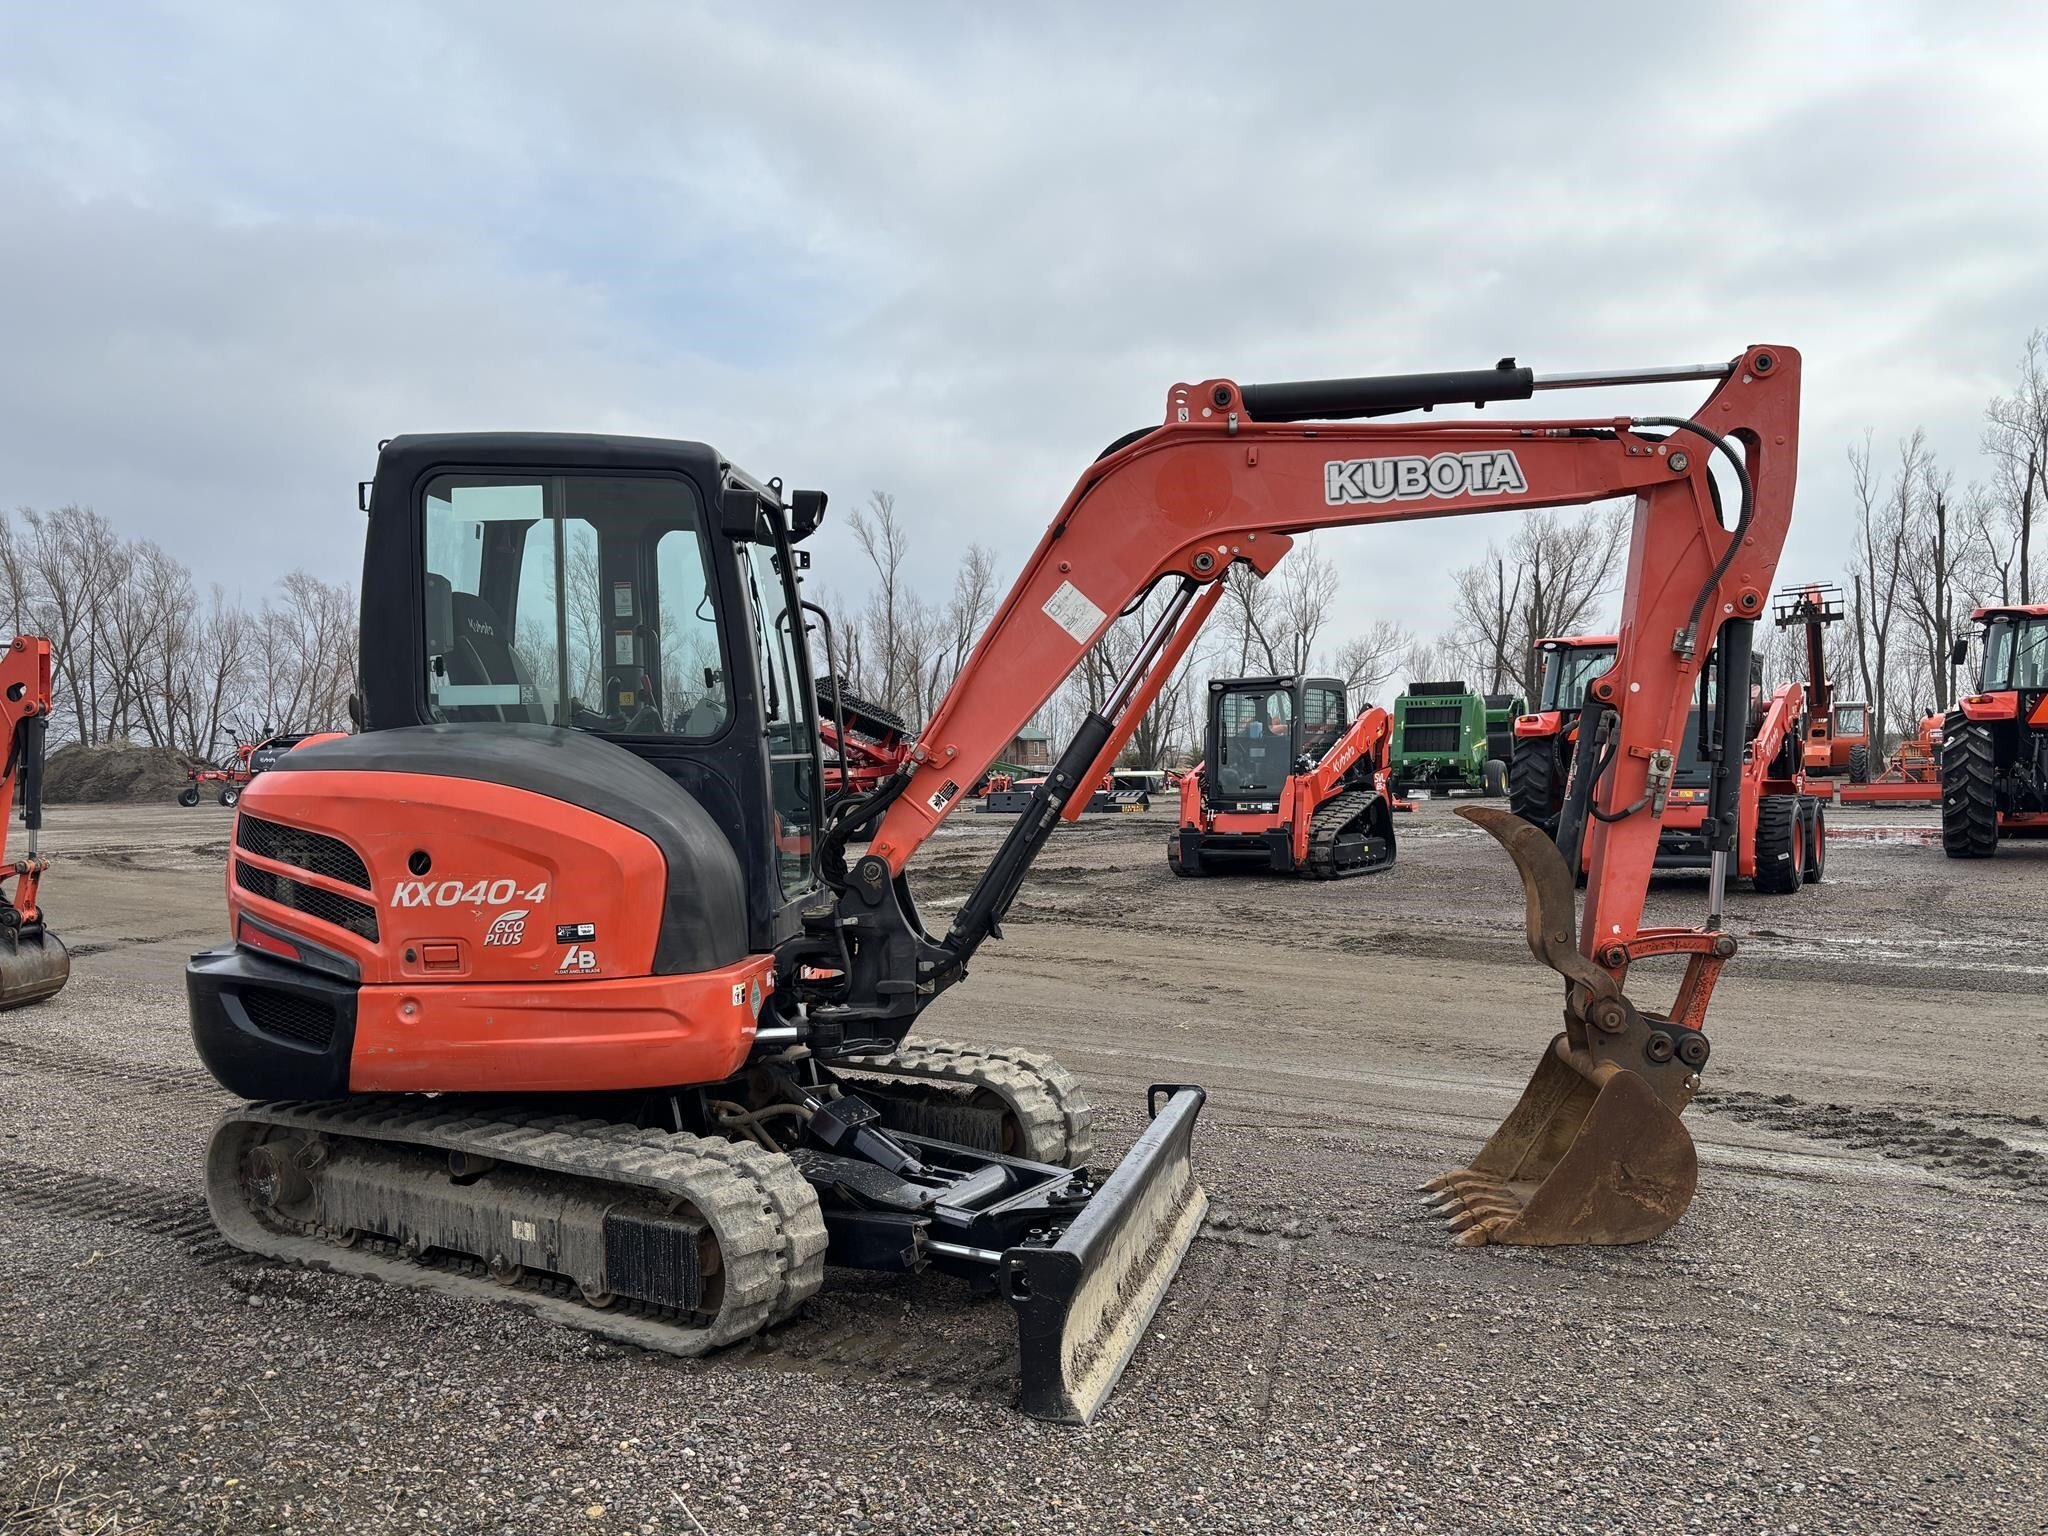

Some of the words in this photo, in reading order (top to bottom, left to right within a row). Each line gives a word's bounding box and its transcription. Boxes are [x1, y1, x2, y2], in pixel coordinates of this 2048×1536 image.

[1327, 453, 1525, 502] KUBOTA
[1332, 745, 1355, 772] Kubota
[390, 879, 548, 908] KX040-4
[483, 932, 523, 946] PLUS
[493, 918, 525, 934] eco
